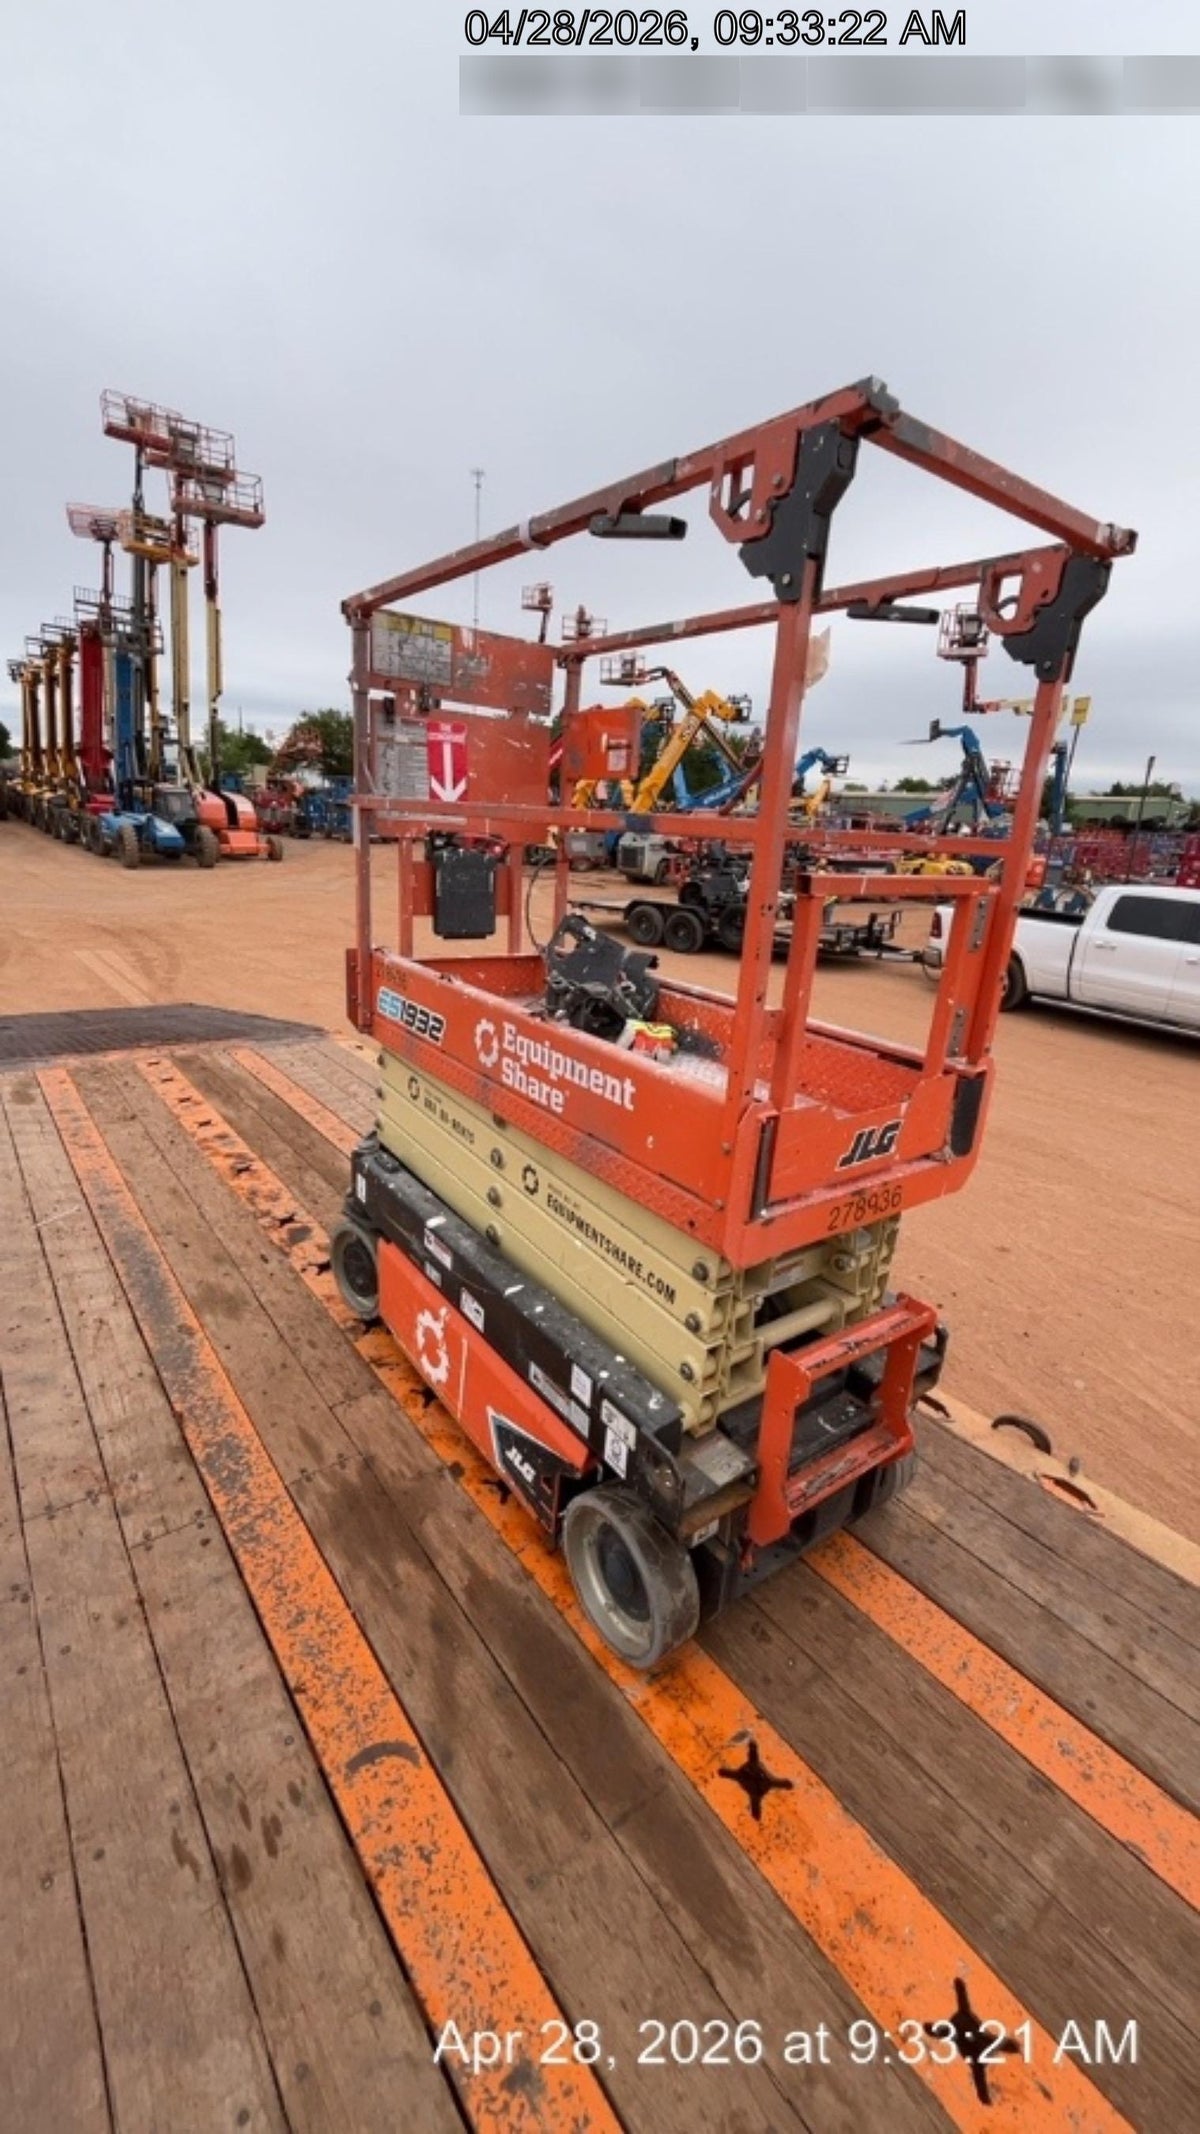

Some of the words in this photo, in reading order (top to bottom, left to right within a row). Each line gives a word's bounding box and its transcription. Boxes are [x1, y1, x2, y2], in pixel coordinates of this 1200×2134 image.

[379, 990, 444, 1041] ES1932
[502, 1022, 637, 1111] Equipment
[502, 1057, 564, 1113] Share
[837, 1121, 902, 1168] JLG
[828, 1185, 903, 1231] 278936
[547, 1193, 676, 1305] EQUIPMENTSHARE.COM
[505, 1445, 536, 1482] JLG
